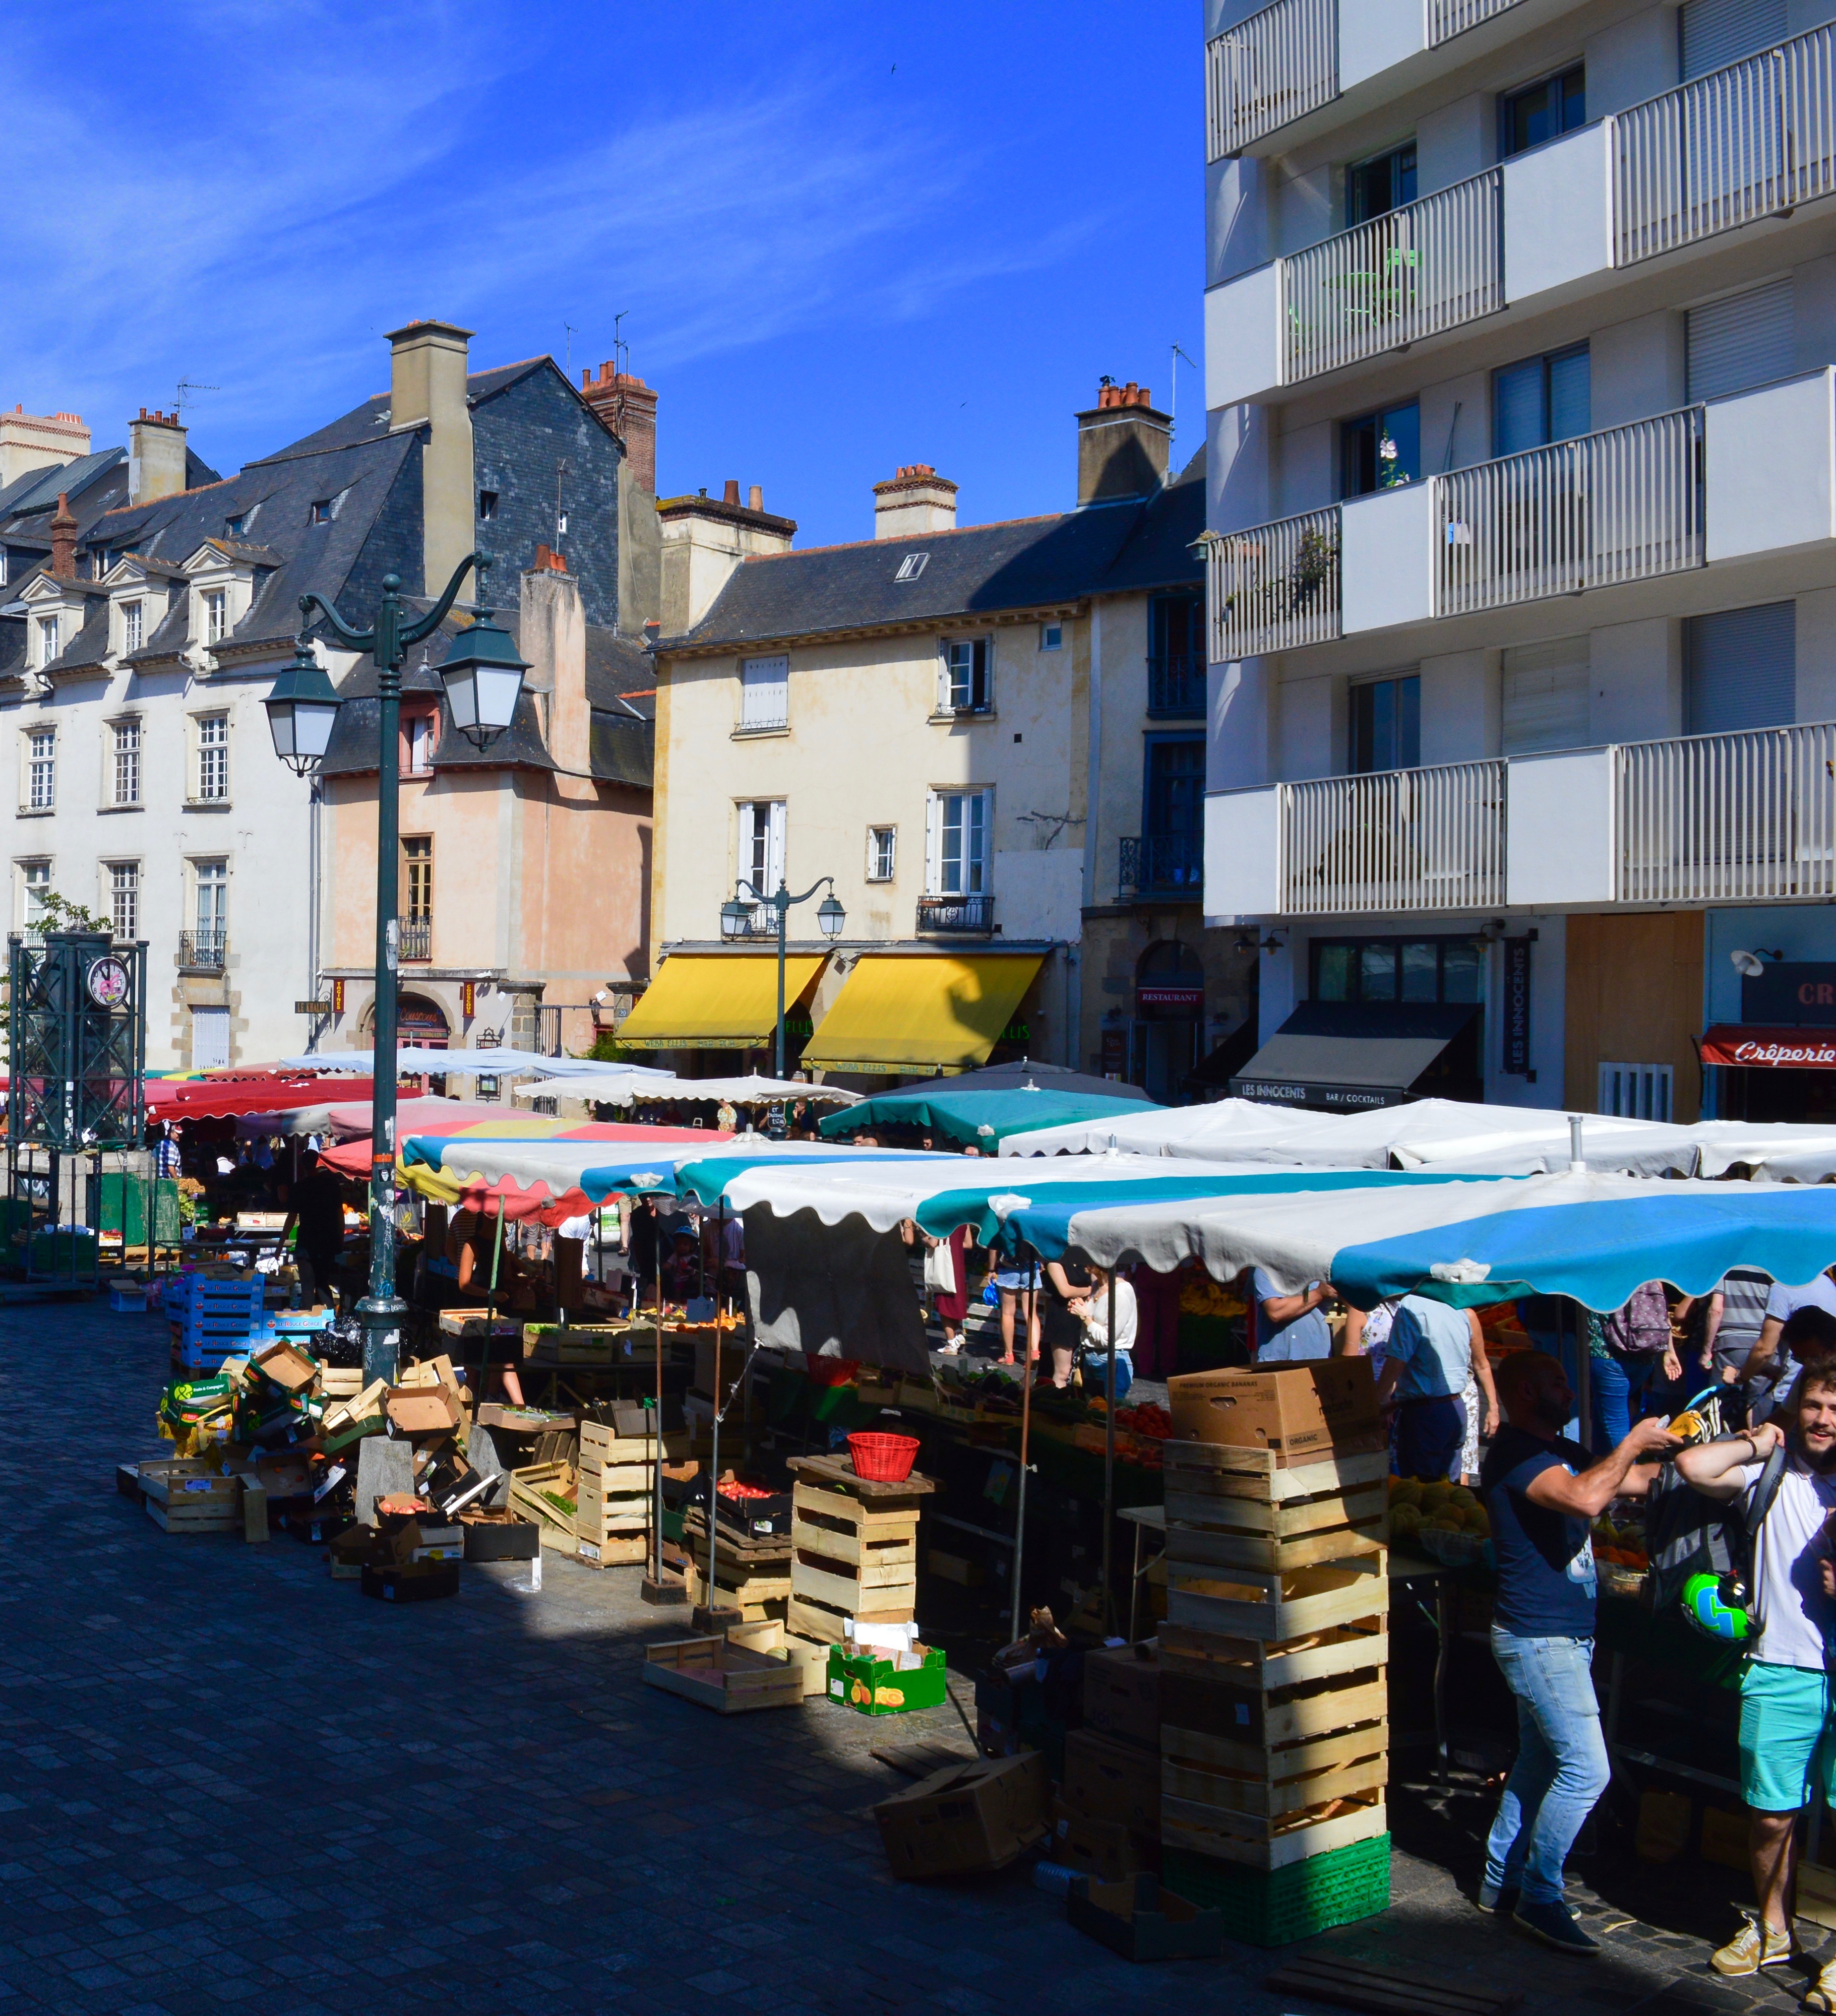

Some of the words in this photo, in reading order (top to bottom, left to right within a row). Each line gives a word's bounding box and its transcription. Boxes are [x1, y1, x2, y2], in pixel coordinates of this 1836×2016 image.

[1142, 993, 1198, 1001] RESTAURANT
[1513, 948, 1524, 1036] INNOCENTS
[297, 1002, 304, 1013] LE
[306, 1002, 329, 1013] KHALIFA
[400, 1007, 438, 1023] Couscous
[644, 1039, 664, 1047] WEBB
[667, 1039, 687, 1047] ELLIS
[1512, 1040, 1524, 1064] LES
[1735, 1041, 1836, 1066] Crêperie
[835, 1062, 859, 1072] WEBB
[862, 1063, 886, 1073] ELLIS
[1242, 1084, 1255, 1096] LES
[1257, 1085, 1306, 1100] INNOCENTS
[1326, 1093, 1338, 1101] BAR
[1347, 1094, 1385, 1105] COCKTAILS
[1290, 1433, 1318, 1445] ORGANIC
